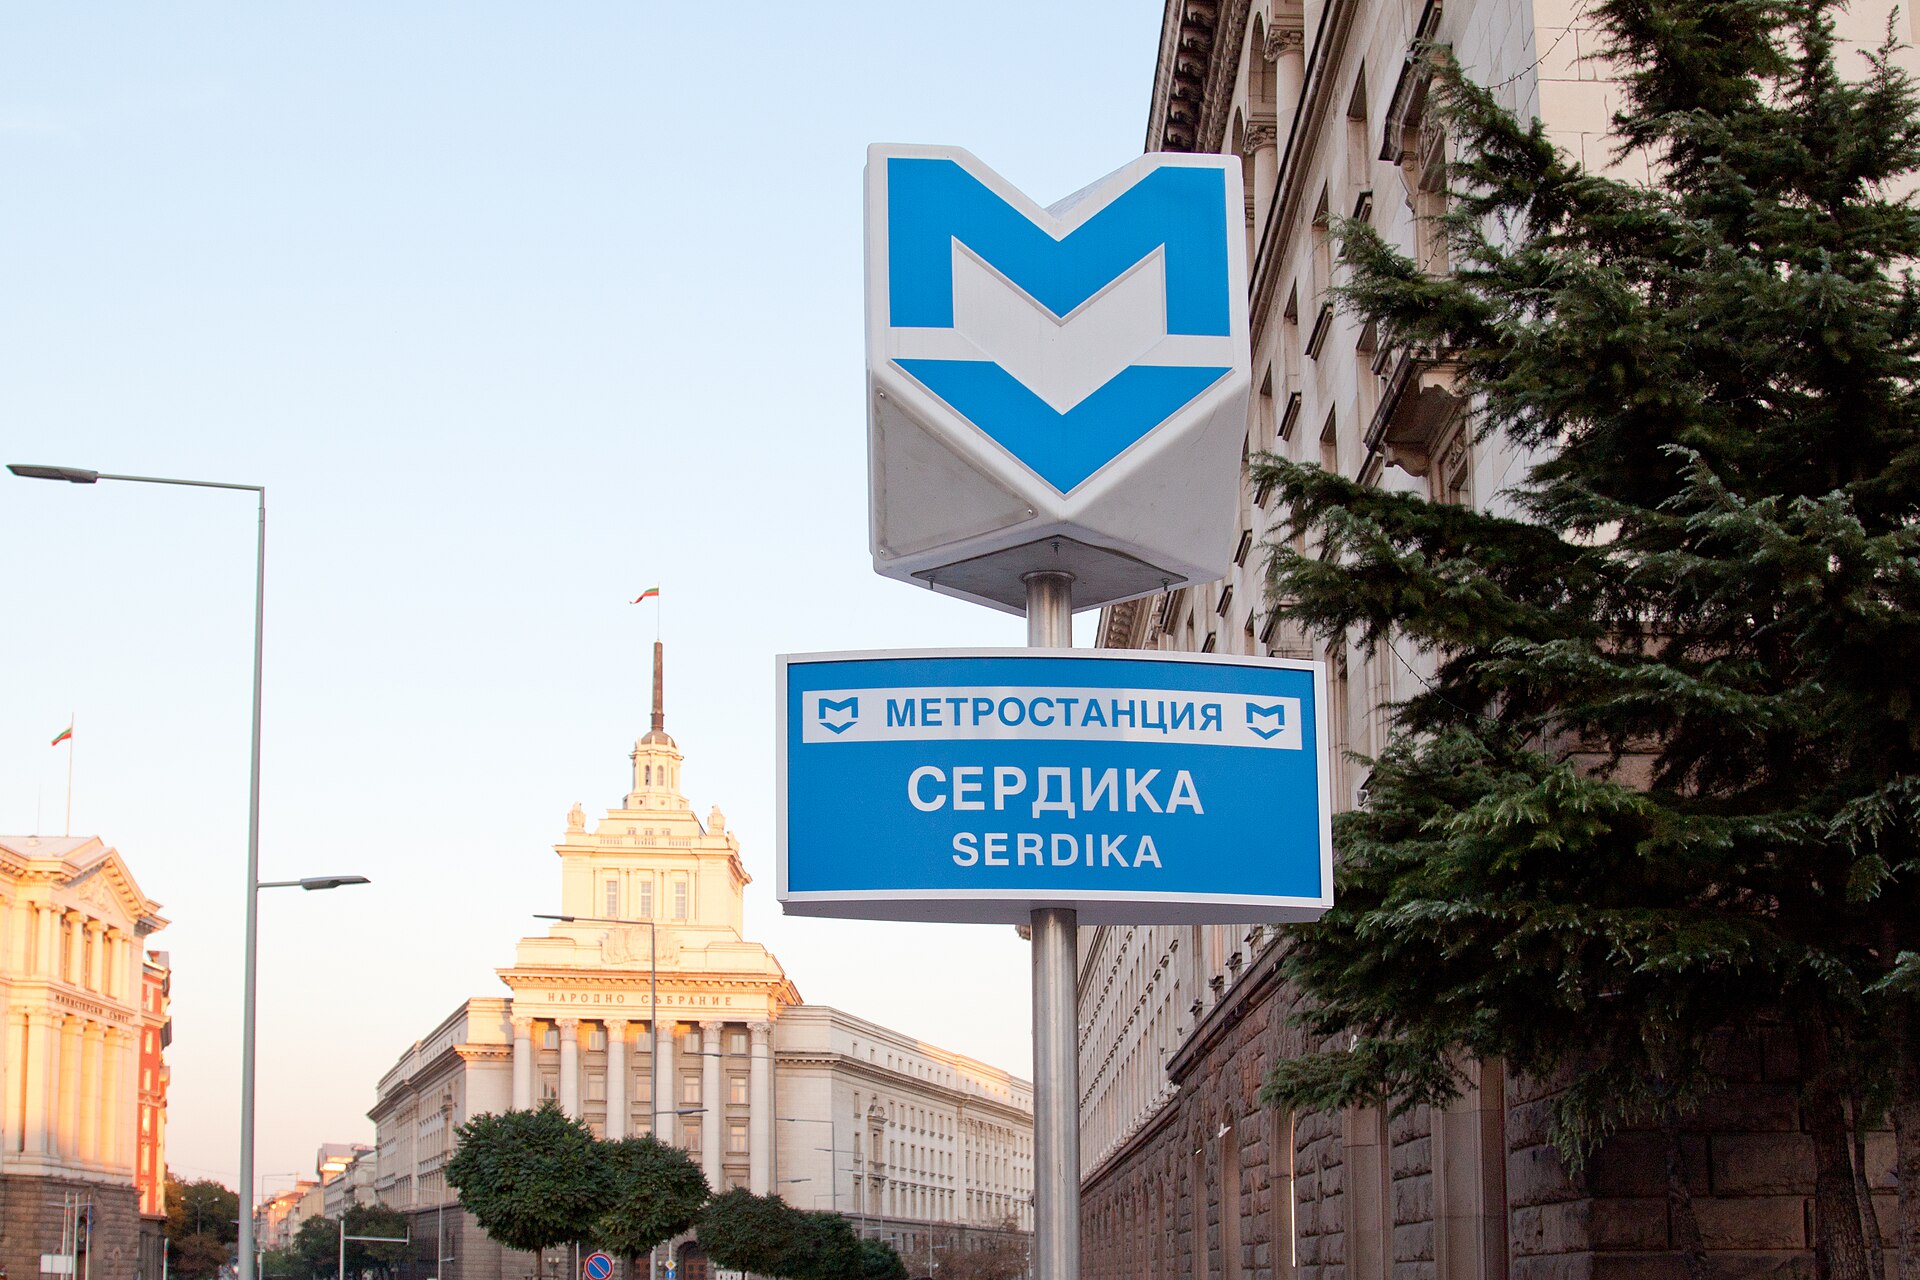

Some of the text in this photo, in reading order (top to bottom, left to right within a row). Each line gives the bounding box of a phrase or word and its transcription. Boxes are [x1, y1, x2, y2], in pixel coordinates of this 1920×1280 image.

[885, 696, 1223, 734] МЕТРОСТАНЦИЯ
[907, 765, 1205, 819] СЕРДИКА
[951, 832, 1163, 868] SERDIKA
[547, 992, 733, 1006] НАРОДНО СЪБРАНИЕ
